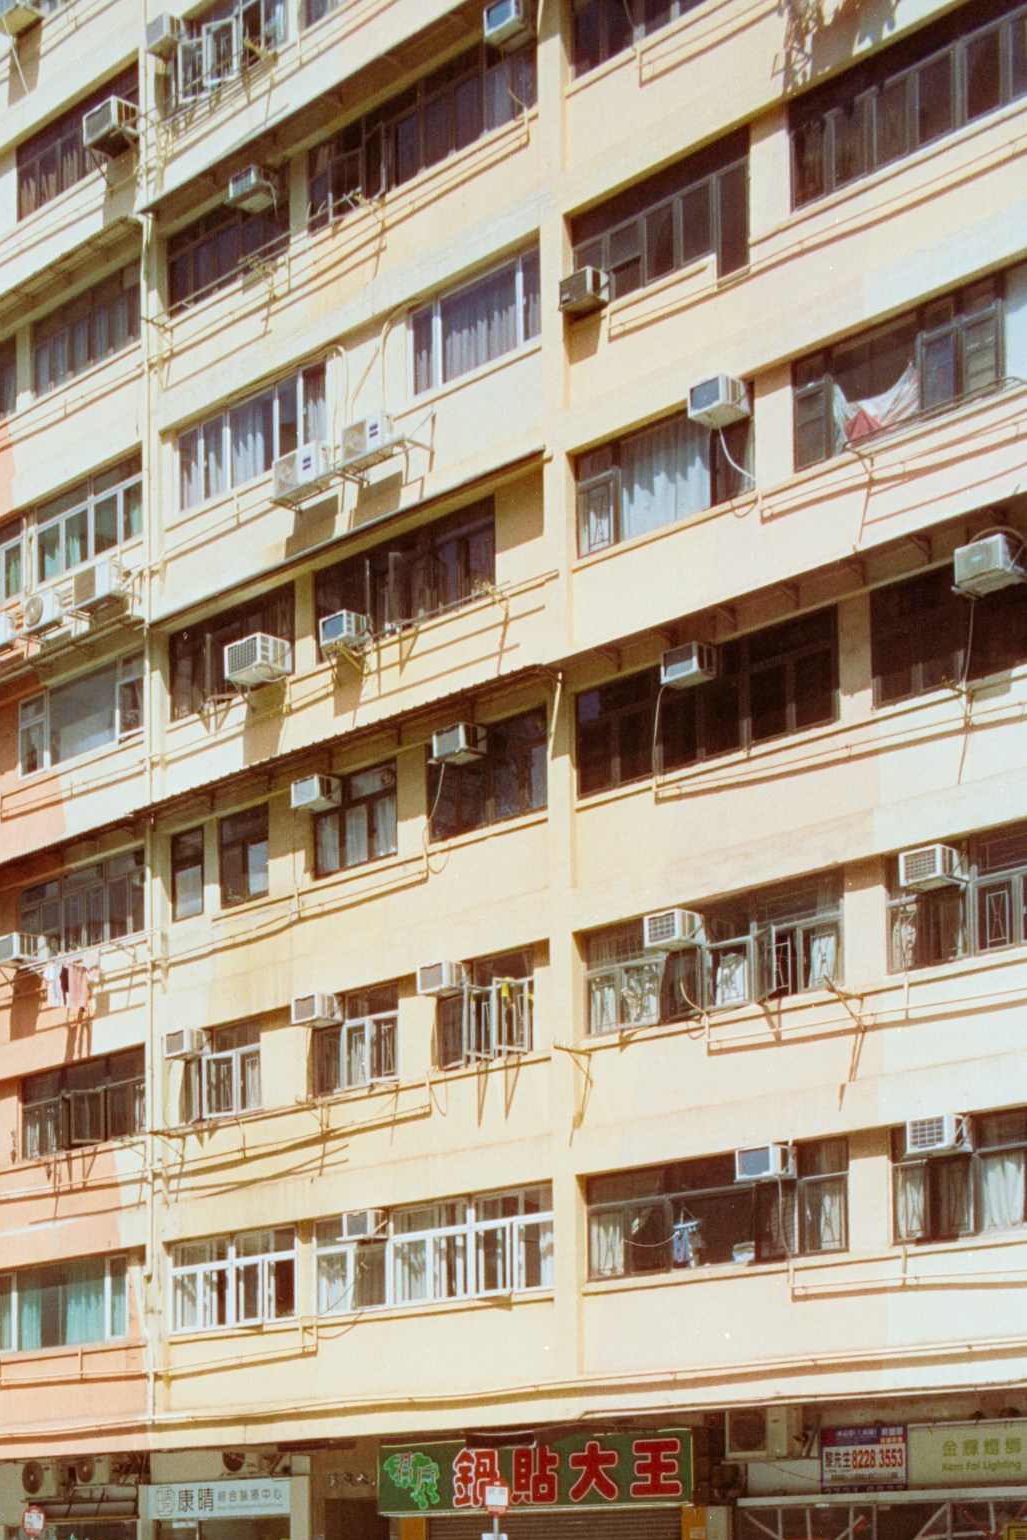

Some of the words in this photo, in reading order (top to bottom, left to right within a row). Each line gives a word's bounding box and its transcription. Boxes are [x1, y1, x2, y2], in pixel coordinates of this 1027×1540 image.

[452, 1437, 683, 1509] 鍋貼大王
[851, 1449, 876, 1468] 8228
[878, 1448, 903, 1468] 3553
